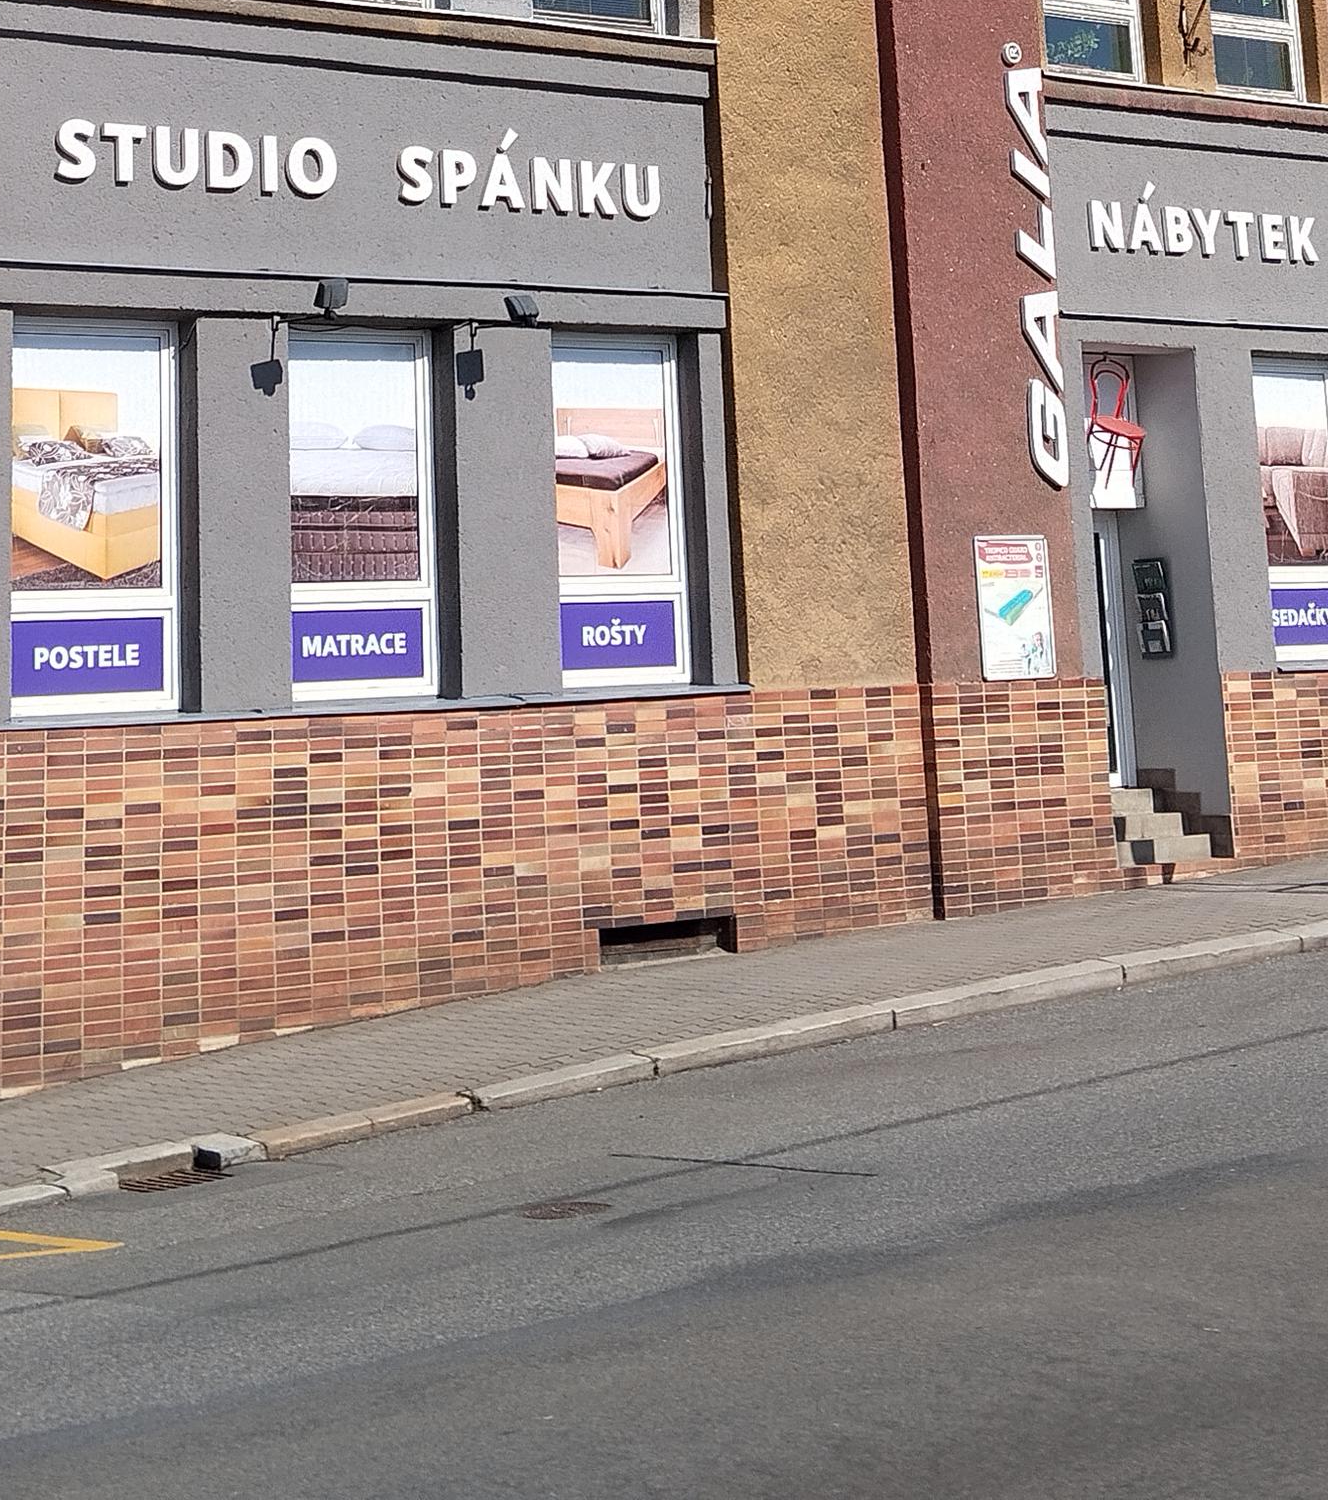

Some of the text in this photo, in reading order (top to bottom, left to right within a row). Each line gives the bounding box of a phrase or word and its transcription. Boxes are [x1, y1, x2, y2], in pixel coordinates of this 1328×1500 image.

[54, 118, 661, 219] STUDIO SPÁNKU
[1087, 182, 1320, 263] NÁBYTEK
[1003, 67, 1070, 490] GALIA
[32, 643, 141, 671] POSTELE
[301, 632, 407, 659] MATRACE
[581, 617, 647, 649] ROŠTY
